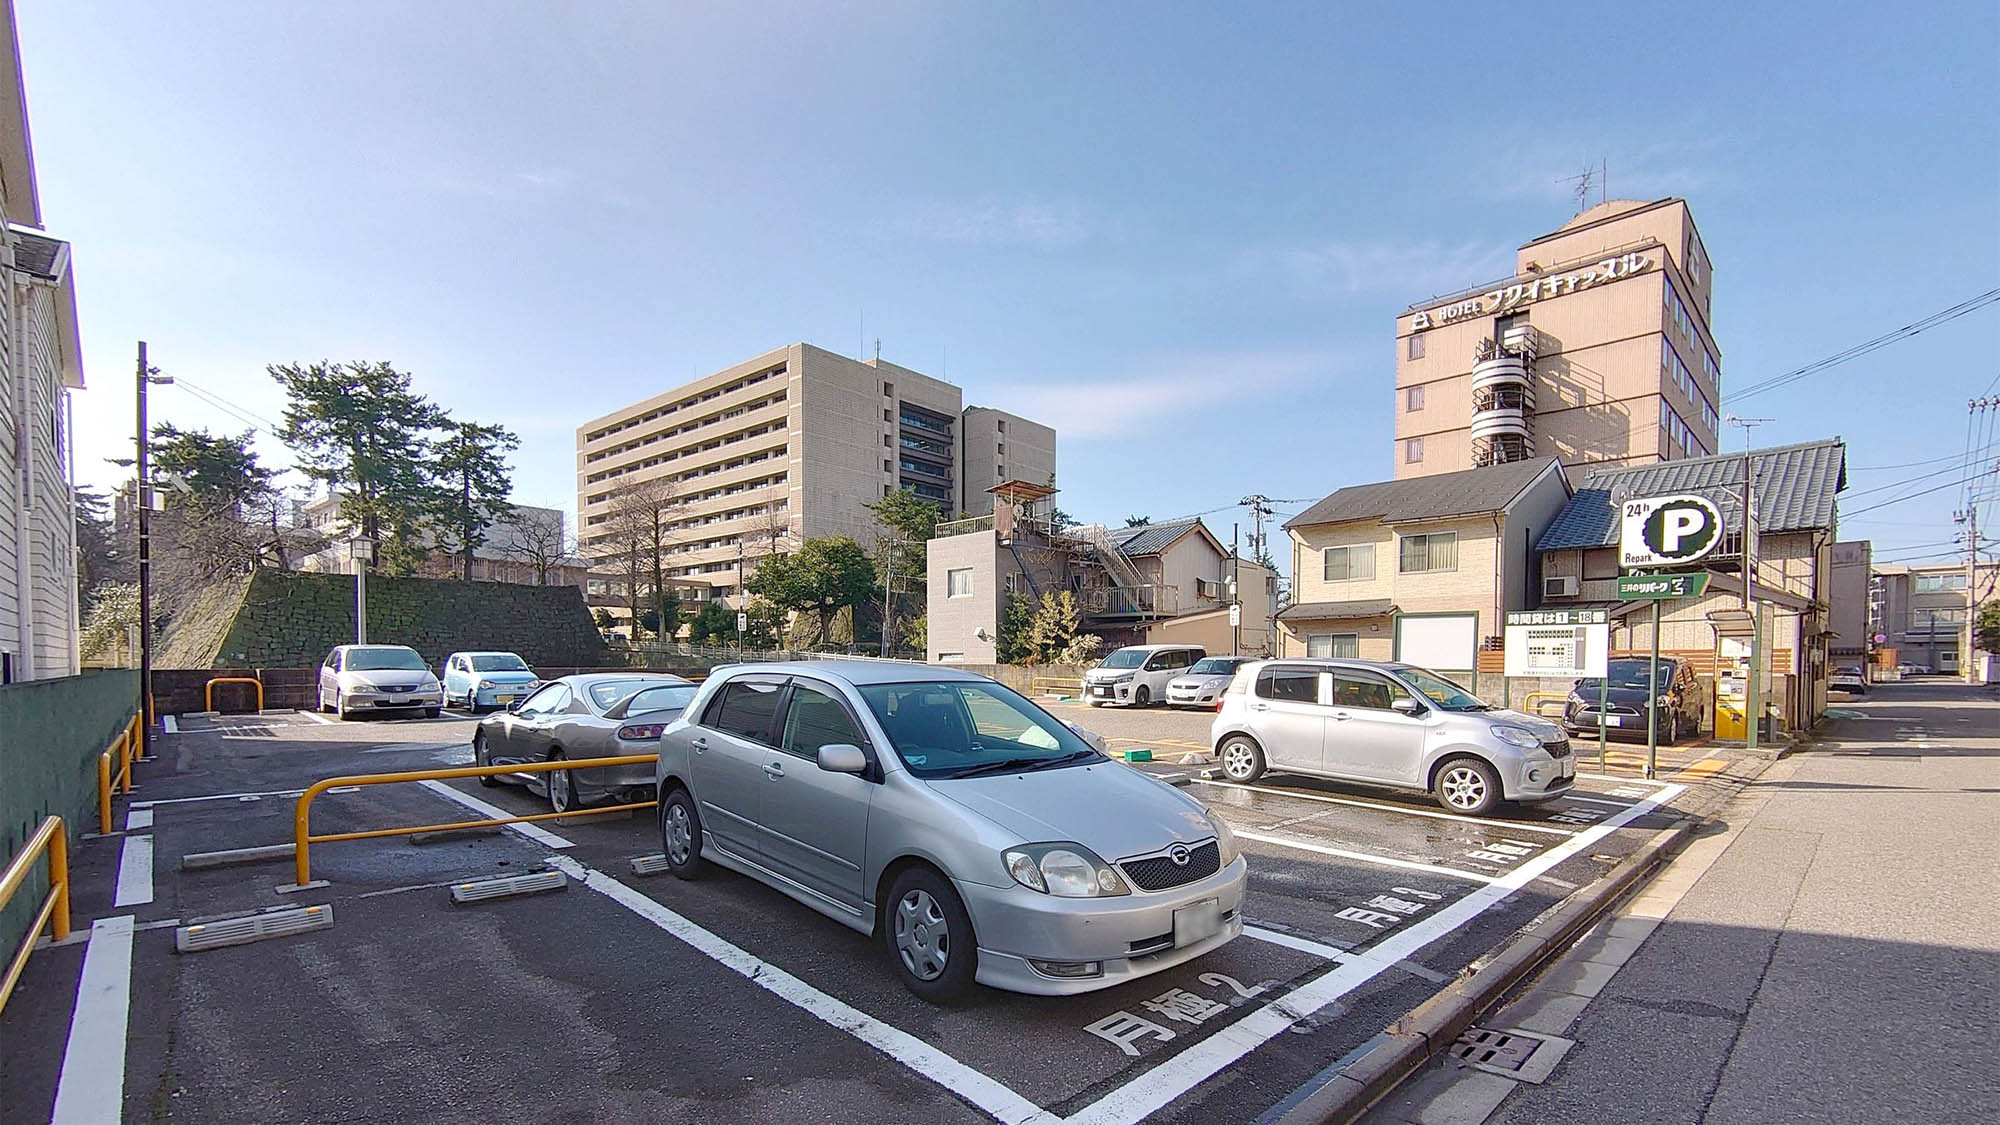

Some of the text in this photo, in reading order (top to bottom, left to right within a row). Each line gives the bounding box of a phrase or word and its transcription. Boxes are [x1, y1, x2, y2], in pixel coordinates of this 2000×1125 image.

[1439, 300, 1480, 321] HOTEL
[1626, 503, 1650, 518] 24h
[1662, 508, 1705, 553] P
[1625, 552, 1652, 564] Repark
[1620, 582, 1669, 594] 三井のリパーク
[1083, 972, 1266, 1056] 月極2
